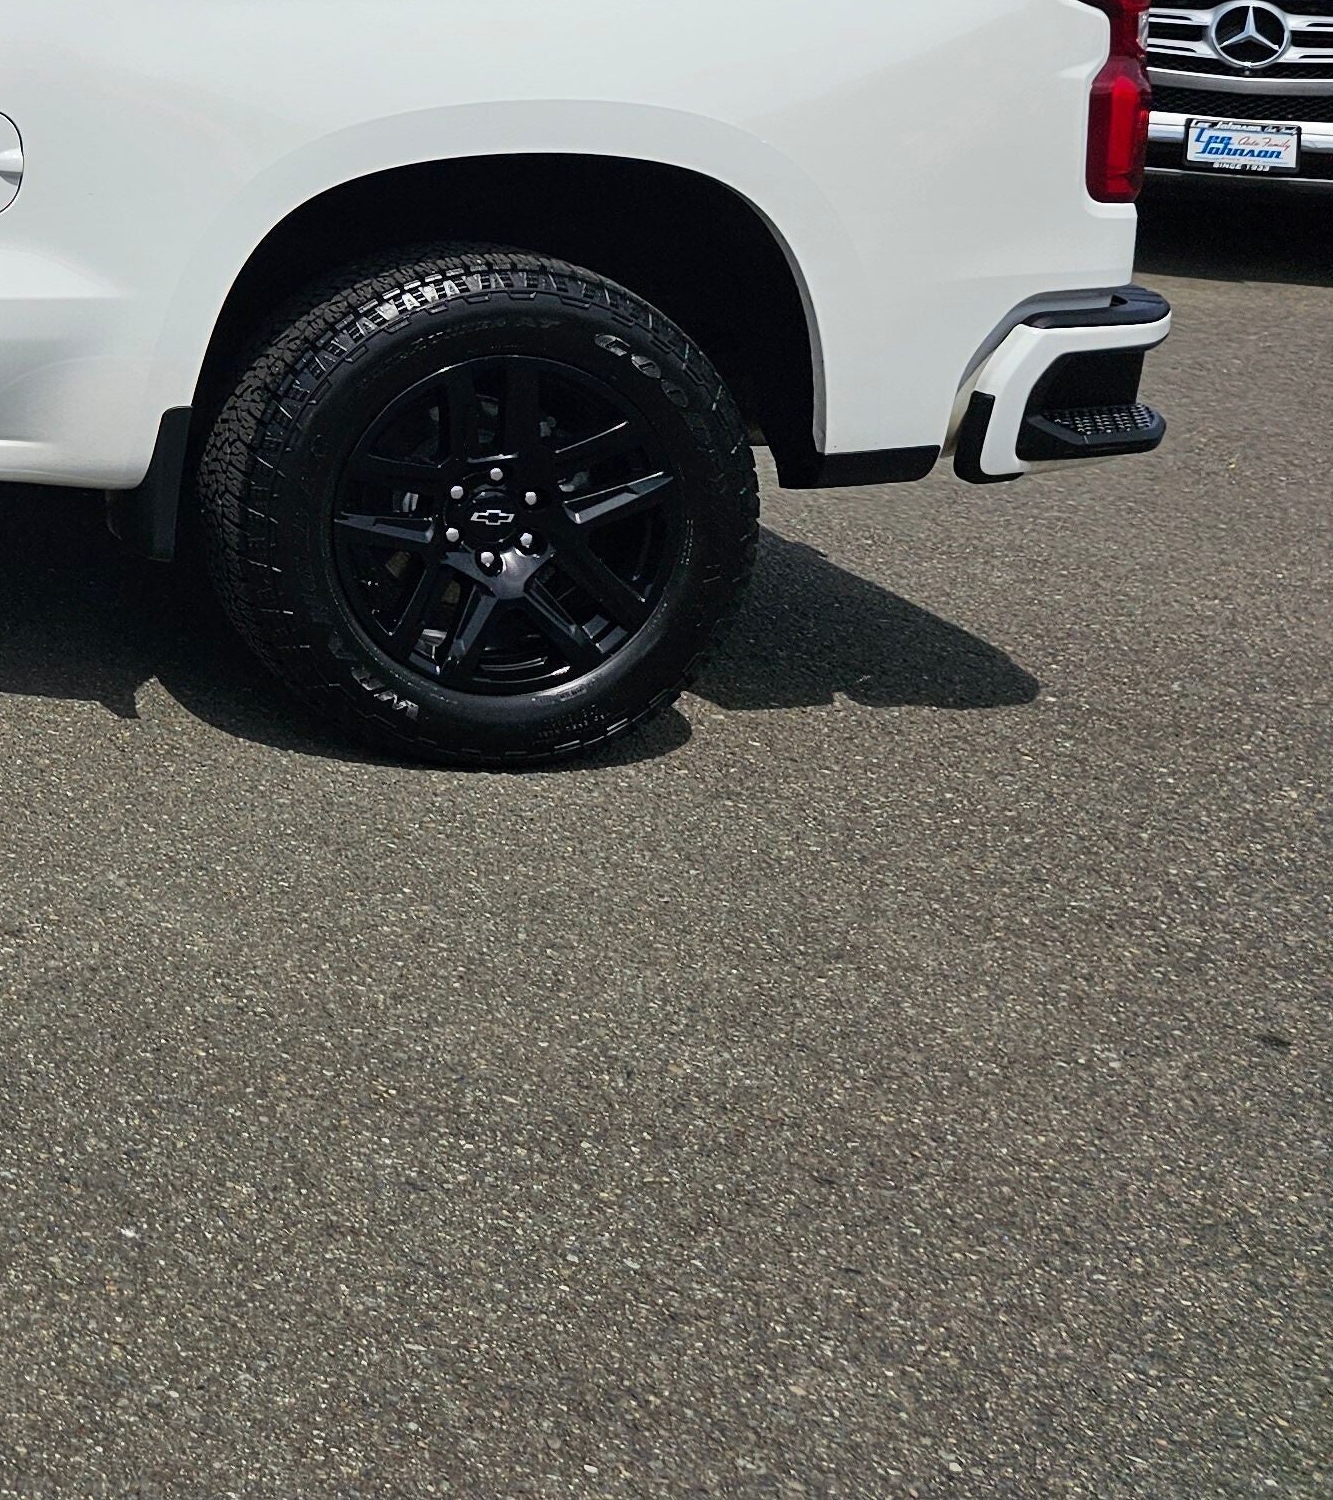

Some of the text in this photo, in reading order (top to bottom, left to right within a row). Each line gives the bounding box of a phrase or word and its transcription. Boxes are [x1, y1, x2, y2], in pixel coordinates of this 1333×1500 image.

[1214, 121, 1263, 132] Johnson
[1194, 127, 1233, 144] Lee
[1195, 137, 1283, 159] Johnson
